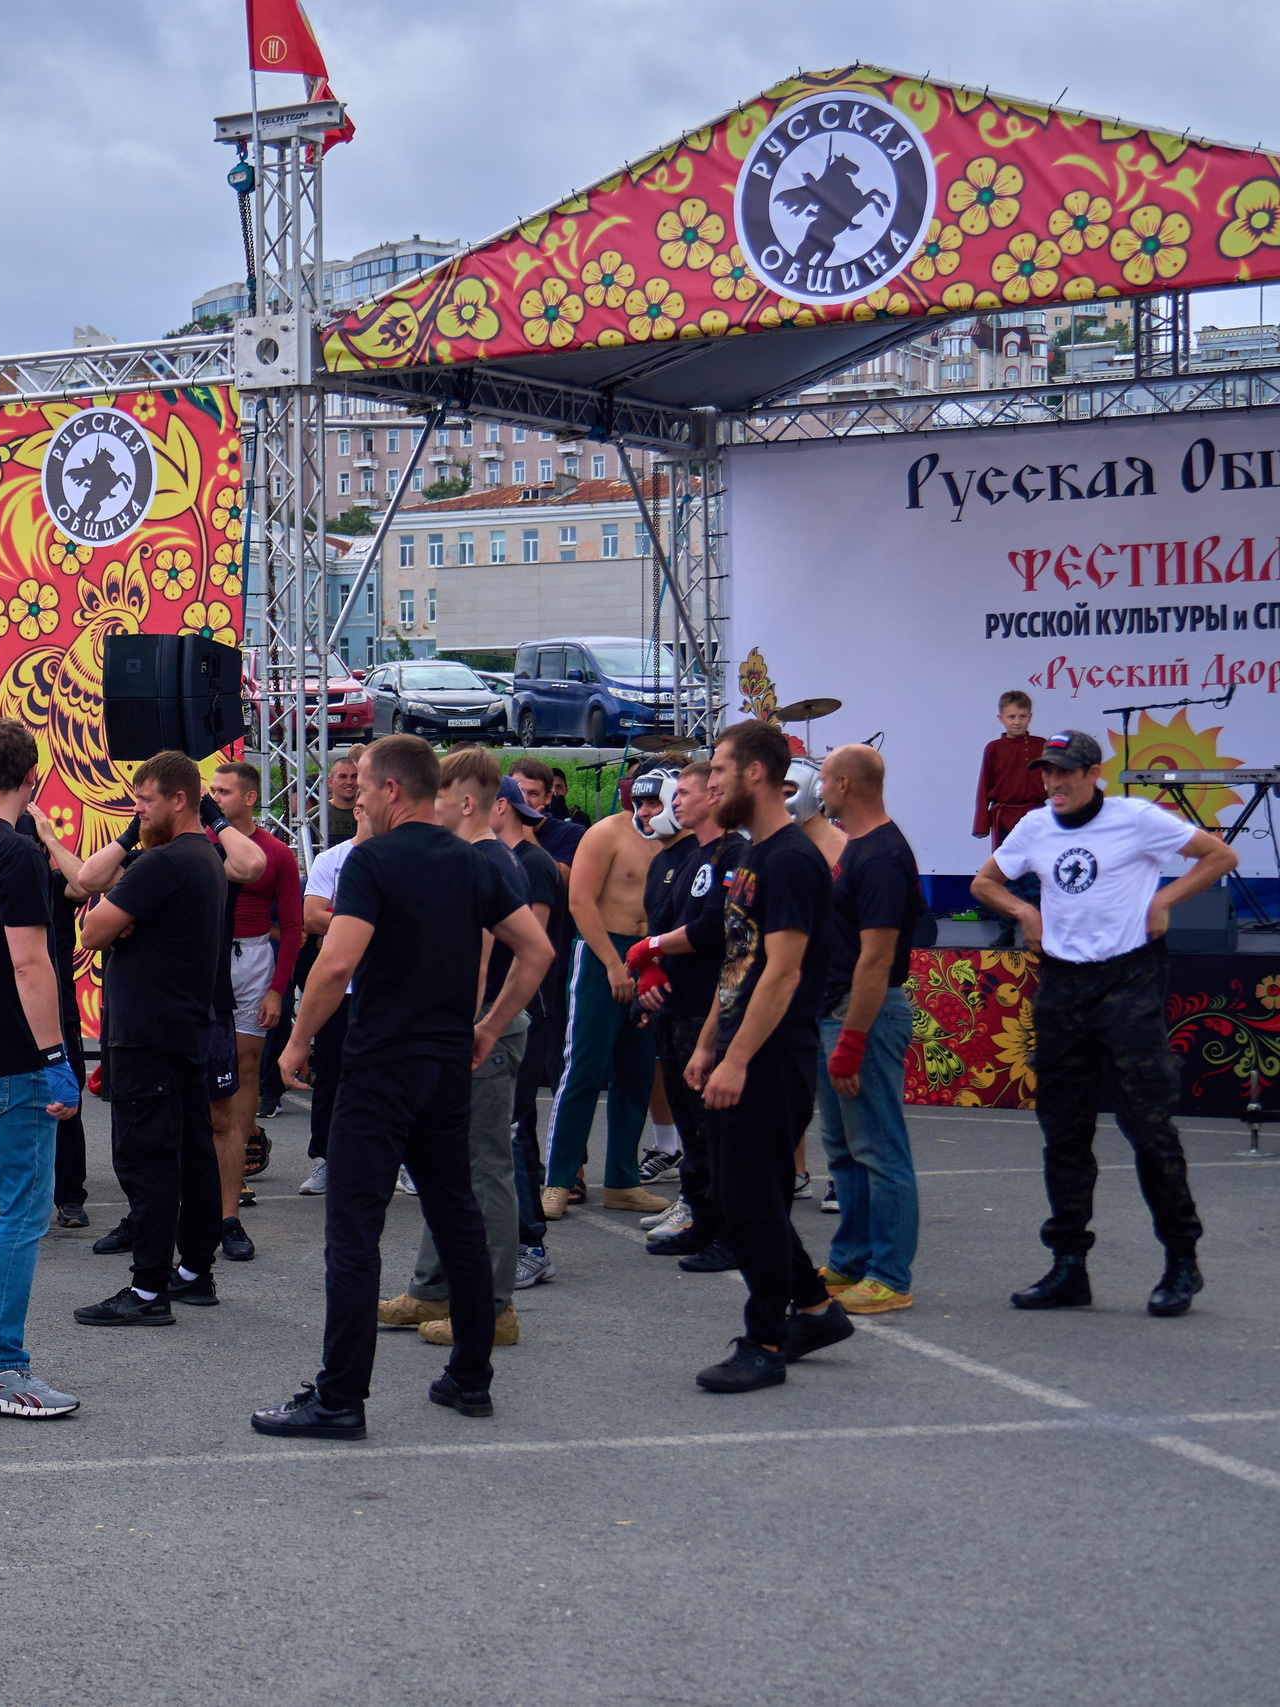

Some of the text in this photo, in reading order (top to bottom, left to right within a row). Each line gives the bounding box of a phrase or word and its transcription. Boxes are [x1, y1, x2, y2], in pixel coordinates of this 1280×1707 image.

[752, 104, 914, 180] РУССКАЯ
[760, 229, 910, 294] ОБЩИНА
[51, 413, 145, 462] РУССКАЯ
[905, 452, 1158, 523] Русская
[56, 499, 143, 540] ОБЩИНА
[984, 602, 1090, 640] РУССКОЙ
[1095, 603, 1228, 636] КУЛЬТУРЫ
[632, 782, 653, 795] ENUM
[1200, 772, 1224, 781] KORG
[1055, 848, 1095, 866] РУССКАЯ
[1057, 878, 1094, 894] ОБЩИНА
